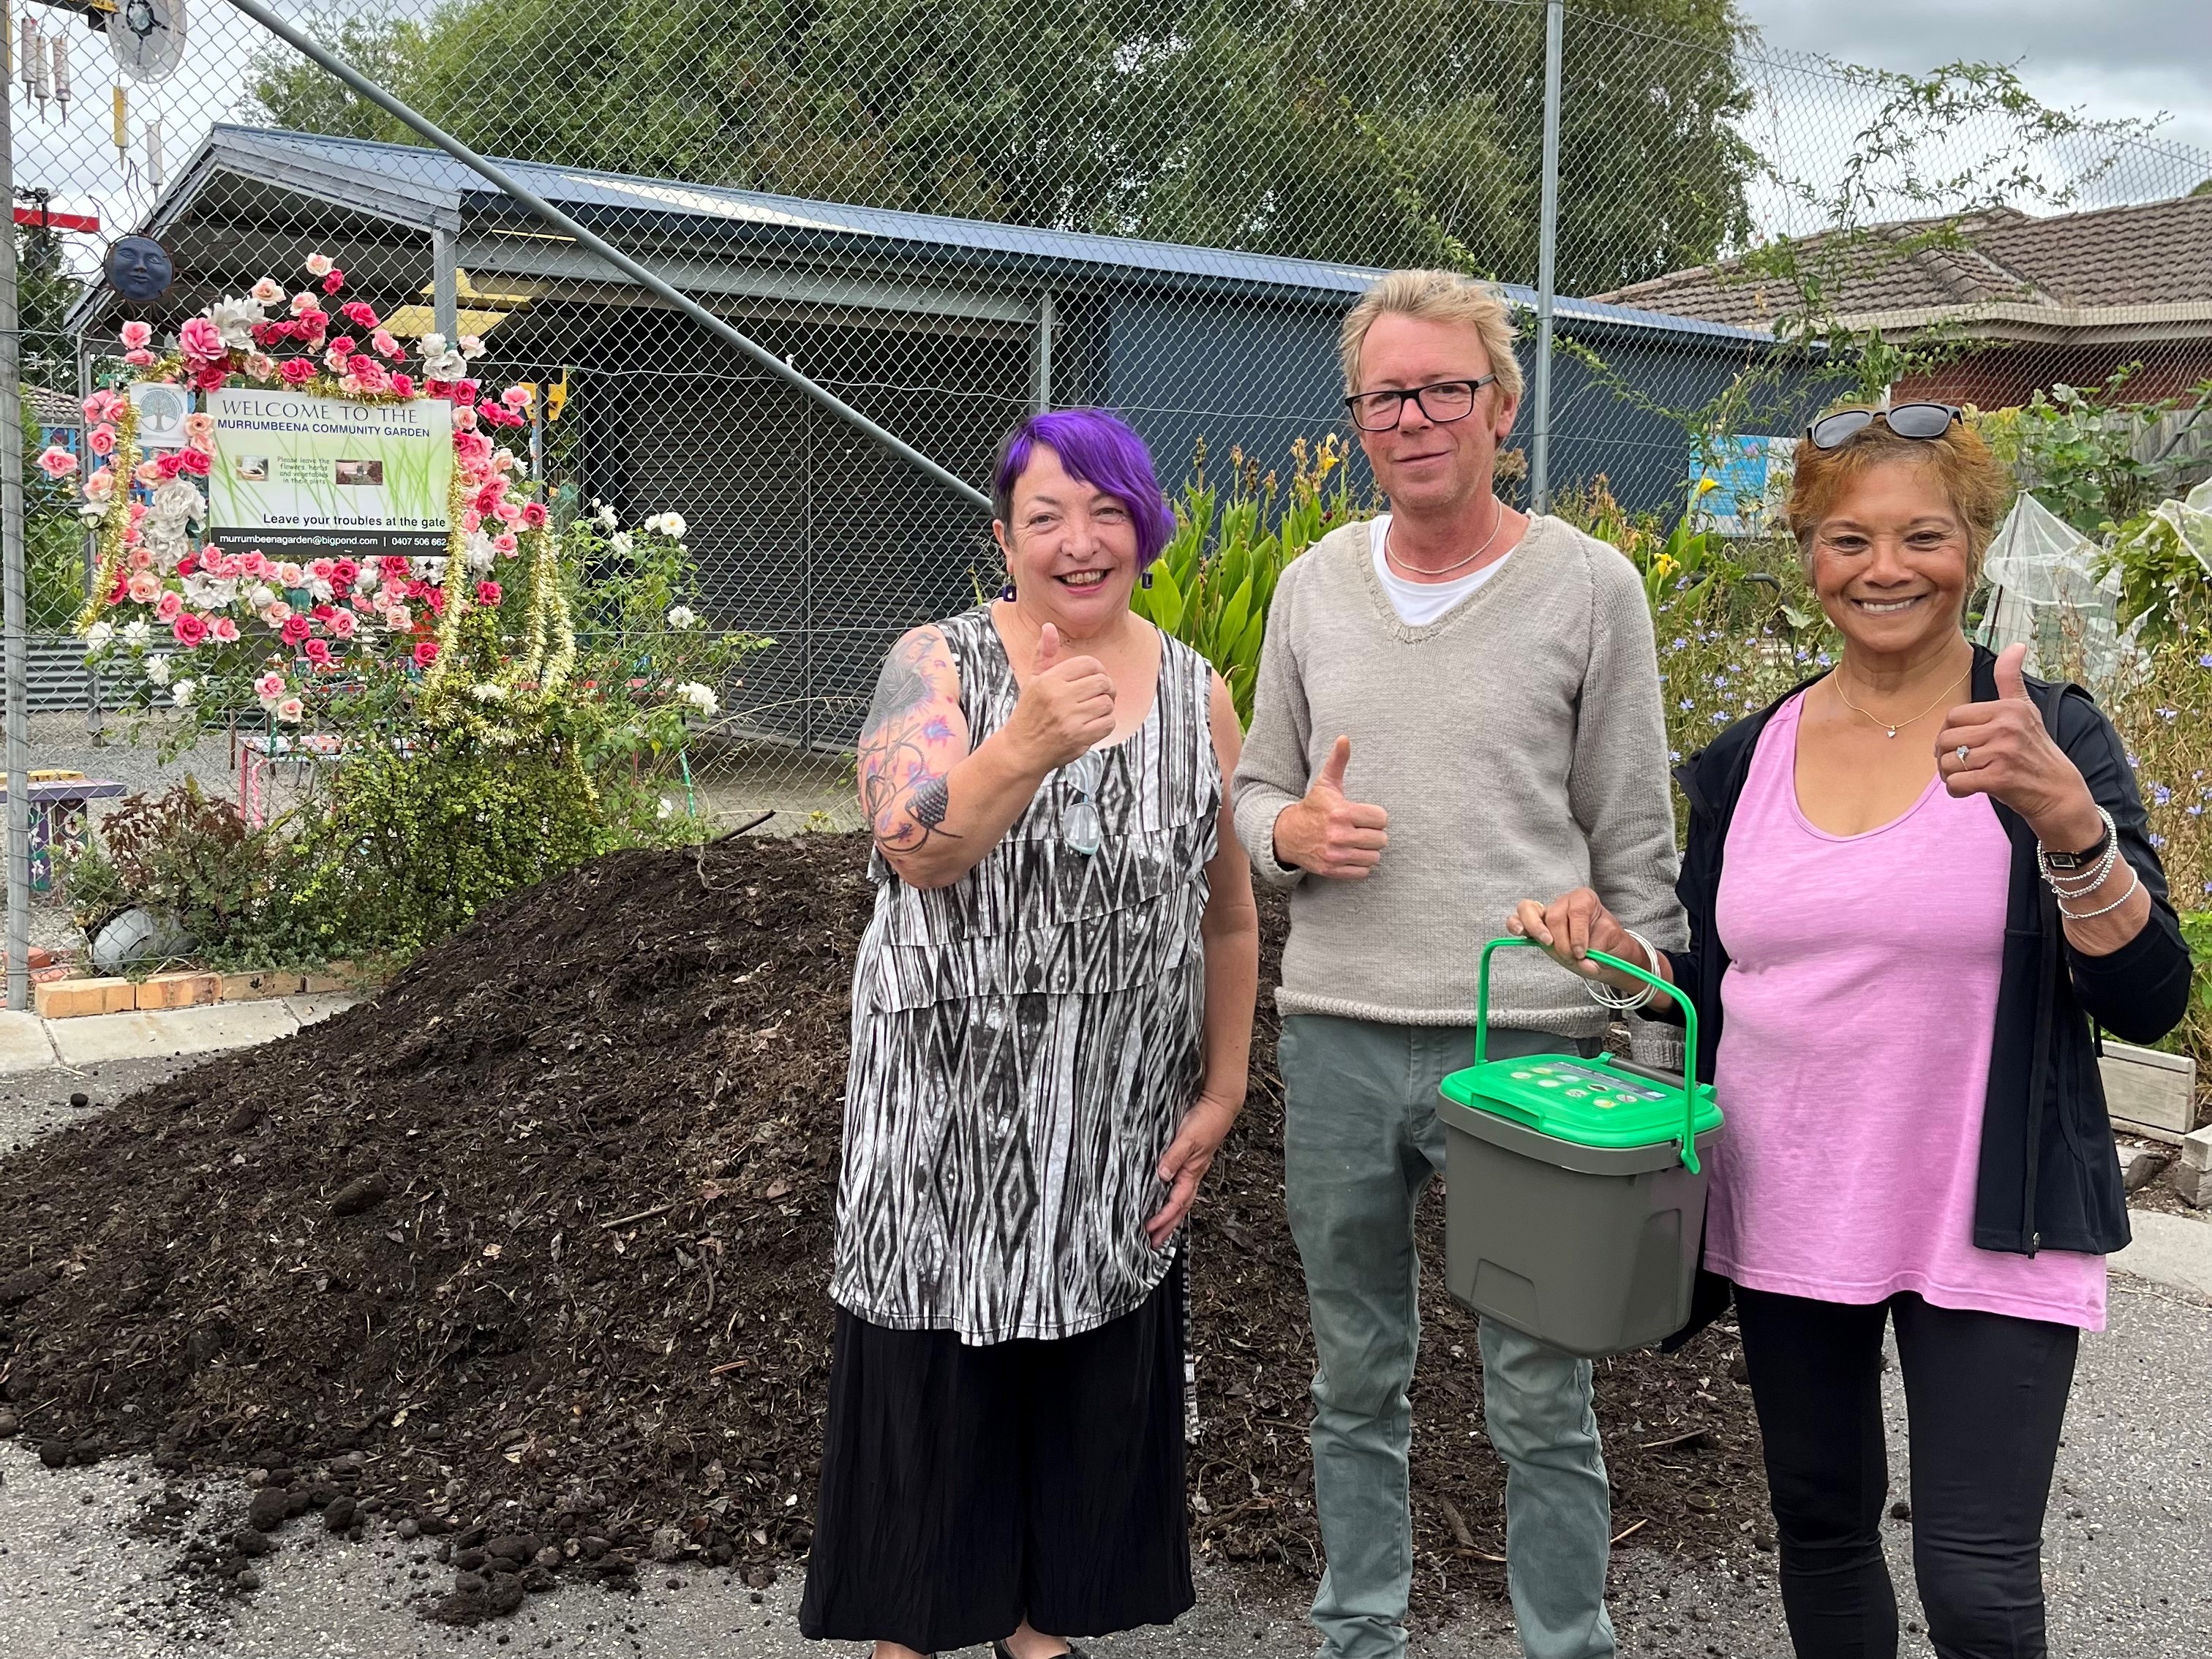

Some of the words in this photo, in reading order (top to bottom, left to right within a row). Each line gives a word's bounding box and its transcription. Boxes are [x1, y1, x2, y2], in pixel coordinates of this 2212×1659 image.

[222, 400, 331, 419] WELCOME
[339, 406, 368, 421] TO
[377, 407, 418, 424] THE
[218, 419, 309, 432] MURRUMBEENA
[312, 424, 380, 435] COMMUNITY
[384, 426, 429, 437] GARDEN
[263, 514, 299, 524] Leave
[304, 516, 329, 527] your
[334, 516, 382, 526] troubles
[385, 517, 396, 526] at
[400, 517, 418, 527] the
[421, 518, 446, 529] gate
[219, 535, 378, 546] murrumbeenagarden@bigpond.com
[391, 537, 413, 546] 0407
[414, 538, 429, 546] 506
[431, 538, 446, 546] 662
